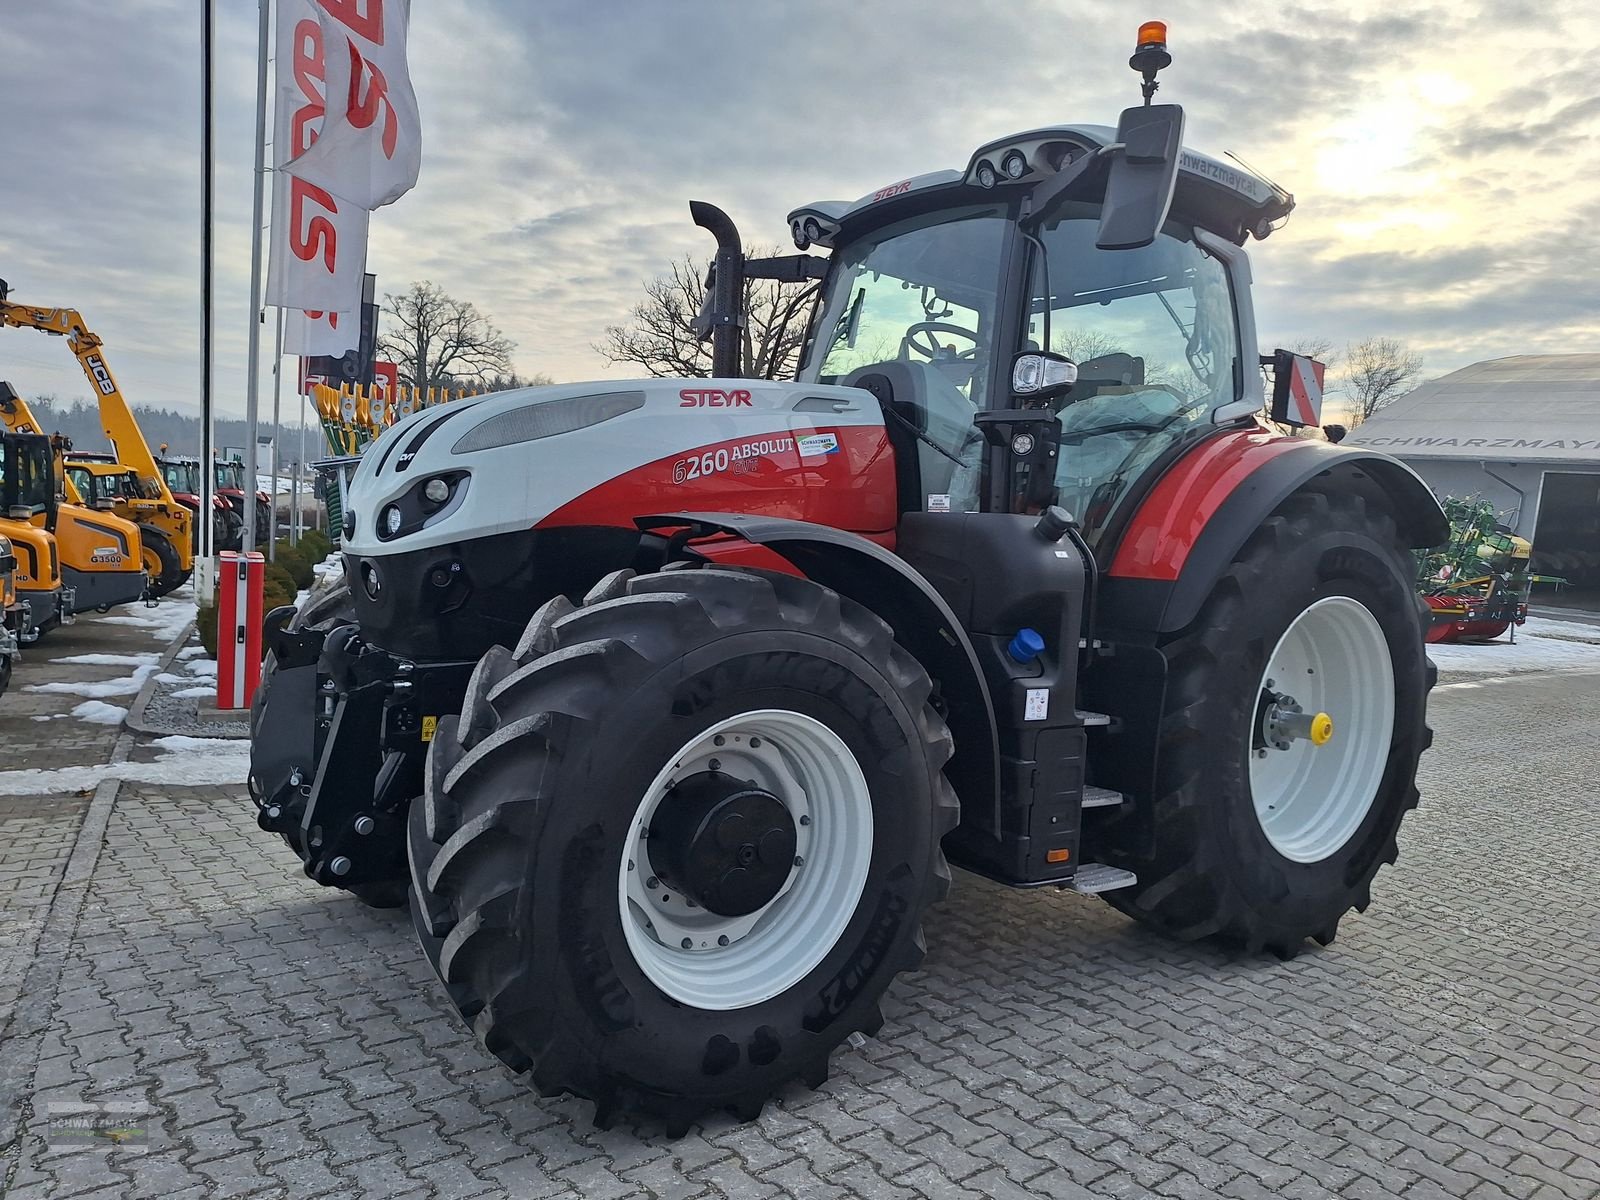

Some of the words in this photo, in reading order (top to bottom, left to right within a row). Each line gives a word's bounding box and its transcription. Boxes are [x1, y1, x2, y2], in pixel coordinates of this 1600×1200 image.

[873, 180, 912, 202] STEYR
[86, 354, 117, 396] JCB
[679, 388, 753, 408] STEYR
[1349, 437, 1600, 449] SCHWARZMAY
[672, 448, 729, 485] 6260
[731, 438, 794, 461] ABSOLUT
[91, 556, 122, 564] G3500
